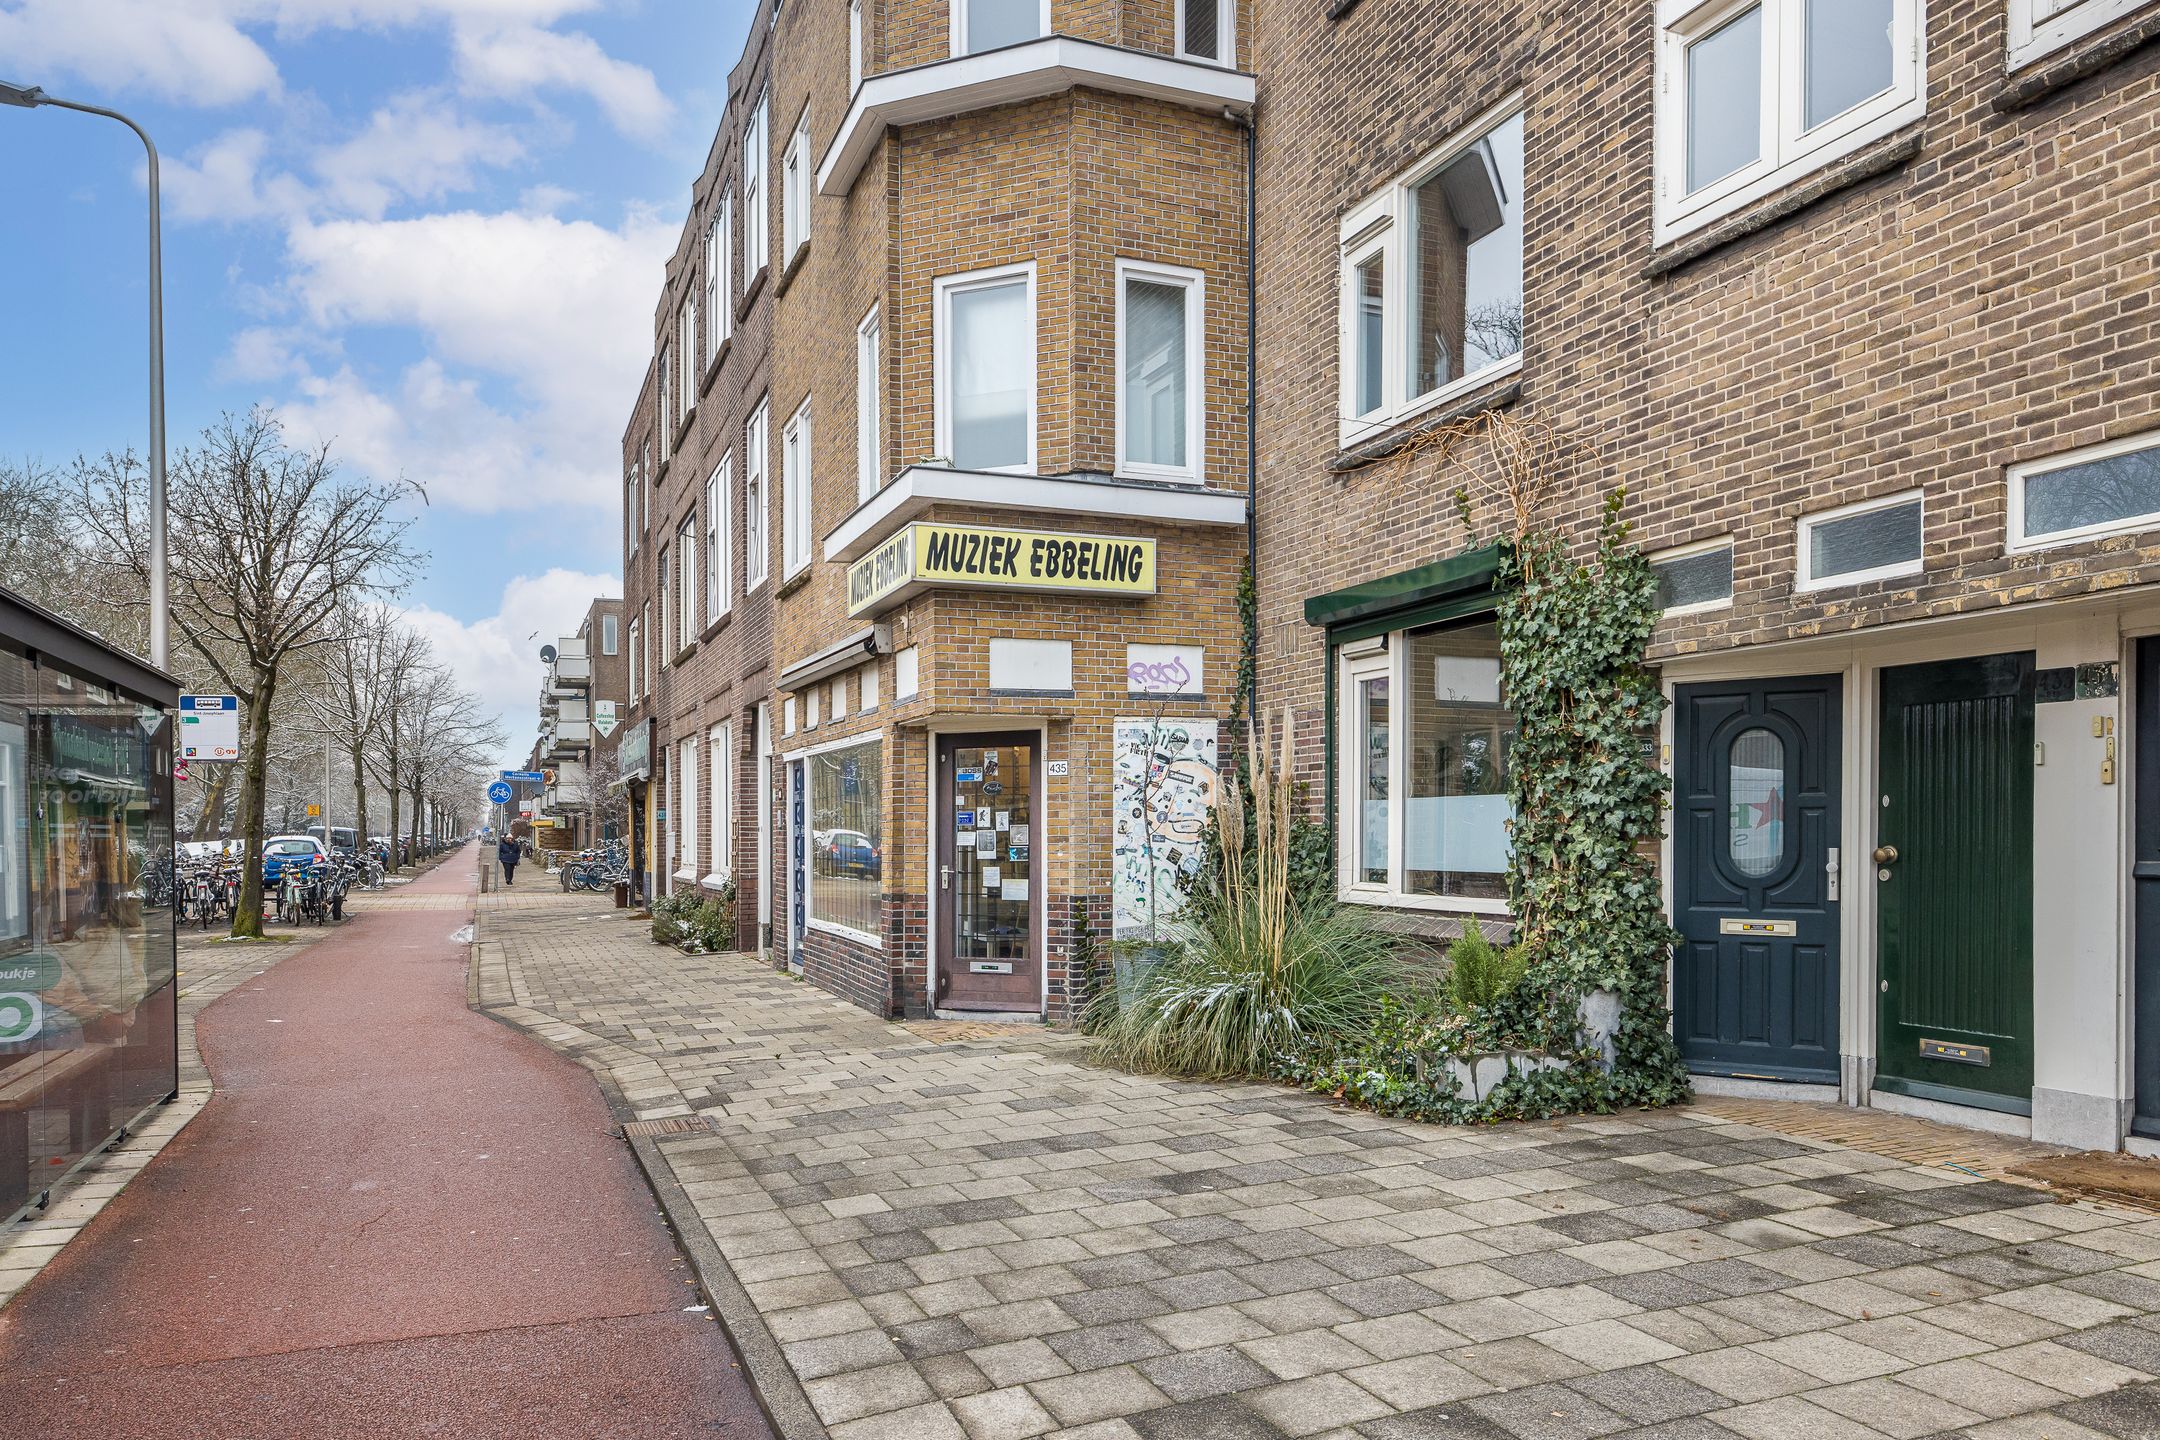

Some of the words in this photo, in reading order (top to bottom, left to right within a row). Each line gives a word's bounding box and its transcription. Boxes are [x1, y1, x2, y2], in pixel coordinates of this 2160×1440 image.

[851, 559, 874, 607] MUZIEK
[875, 534, 909, 592] EBBELING
[925, 531, 1021, 578] MUZIEK
[1030, 538, 1143, 583] EBBELING
[1049, 763, 1067, 773] 435
